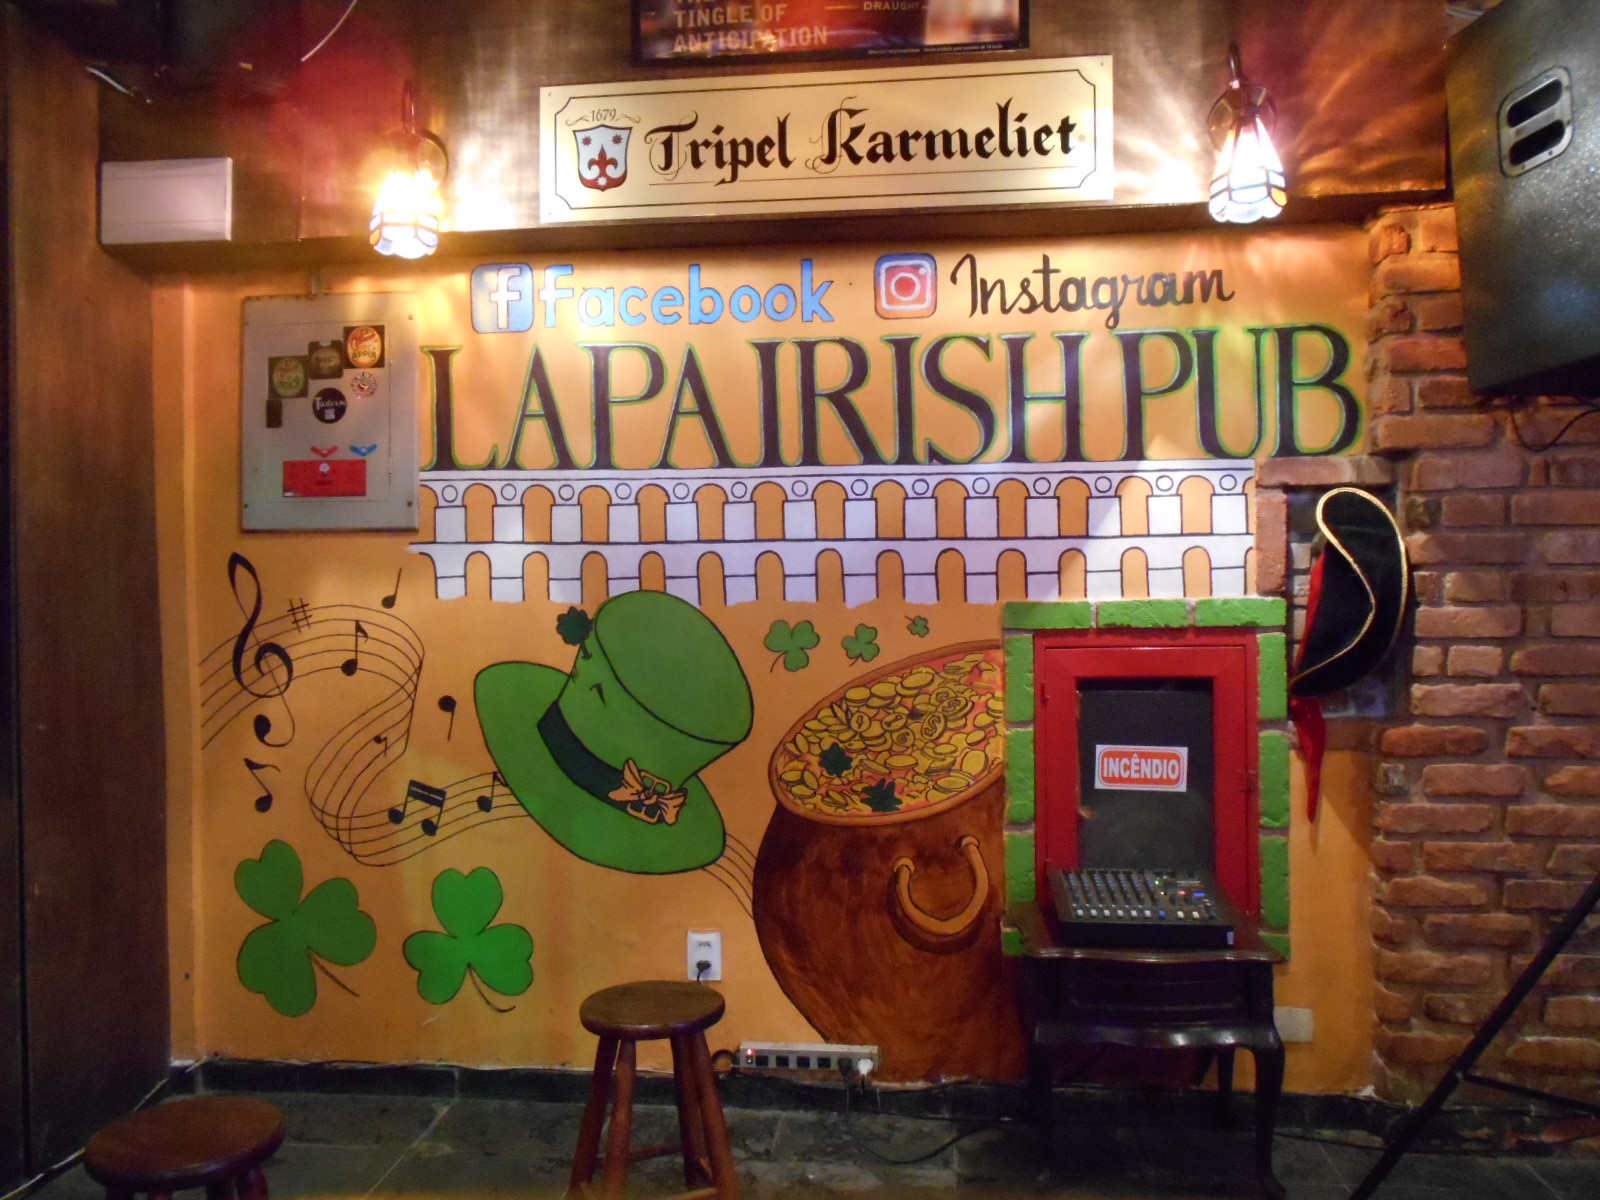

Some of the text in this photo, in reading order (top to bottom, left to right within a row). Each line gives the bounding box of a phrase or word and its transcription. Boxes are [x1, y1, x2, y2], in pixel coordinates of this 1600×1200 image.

[674, 4, 788, 28] TINGLE OF
[863, 1, 919, 11] DRAUGHT
[673, 25, 828, 51] ANTICIPATION
[591, 108, 617, 122] 1679
[644, 95, 1077, 187] Tripel Karmeliet
[538, 259, 835, 328] facebook
[950, 253, 1235, 330] Instagram
[1110, 323, 1364, 462] PUB
[1103, 753, 1179, 780] INCÊNDIO
